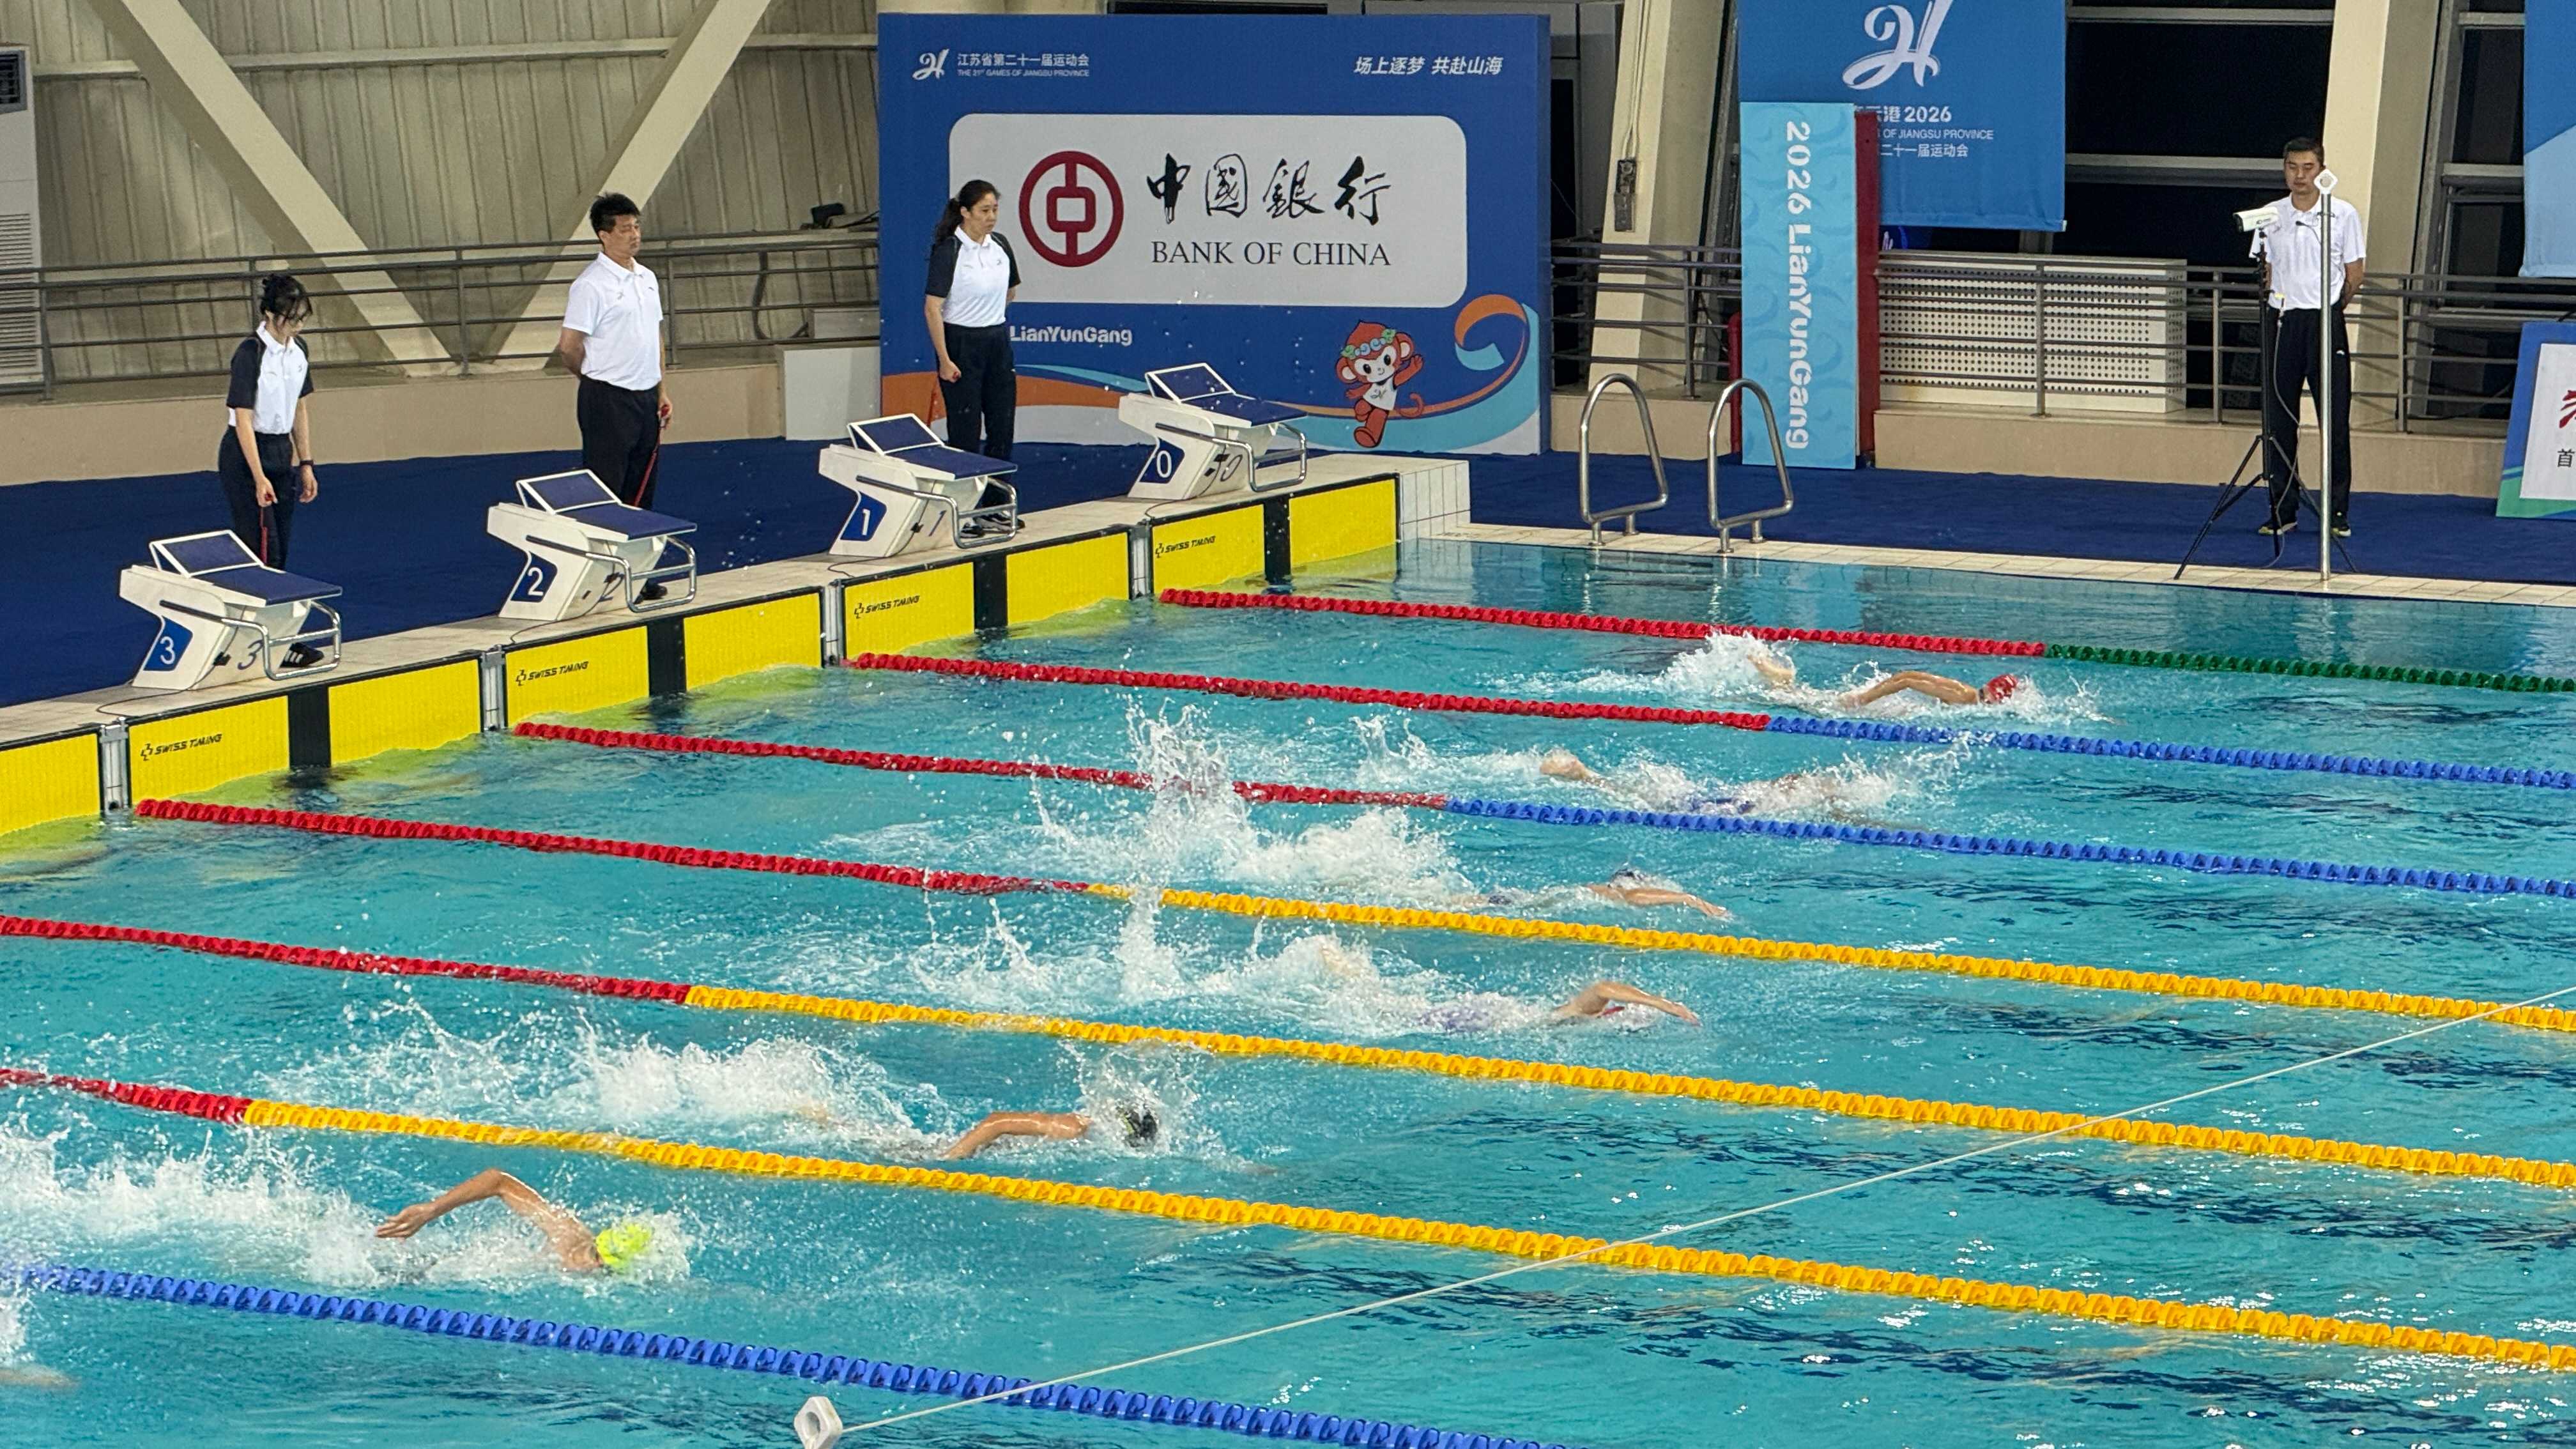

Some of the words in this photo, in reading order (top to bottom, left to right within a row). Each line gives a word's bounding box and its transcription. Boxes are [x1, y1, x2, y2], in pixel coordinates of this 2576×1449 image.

[957, 53, 1089, 66] 江苏省第二十一届运动会
[1353, 56, 1425, 75] 场上逐梦
[1431, 56, 1504, 75] 共赴山海
[1904, 105, 1952, 123] 2026
[1883, 129, 1896, 139] OF
[1898, 129, 1942, 139] JIANGSU
[1943, 130, 1994, 140] PROVINCE
[1786, 121, 1812, 215] 2026
[1151, 241, 1237, 265] BANK
[1244, 241, 1283, 266] OF
[1292, 242, 1392, 266] CHINA
[1009, 325, 1133, 347] LianYunGang
[1786, 224, 1813, 449] LianYunGang
[1156, 450, 1172, 479] 0
[2557, 448, 2575, 468] 首
[862, 509, 871, 536] 1
[1164, 541, 1190, 554] SWISS
[528, 567, 544, 597] 2
[865, 601, 892, 614] SWISS
[894, 595, 921, 608] TIMING
[160, 636, 176, 665] 3
[237, 639, 264, 670] 3
[528, 667, 558, 681] SWISS
[559, 661, 590, 674] TIMING
[154, 740, 188, 755] SWISS
[190, 733, 223, 748] TIMING
